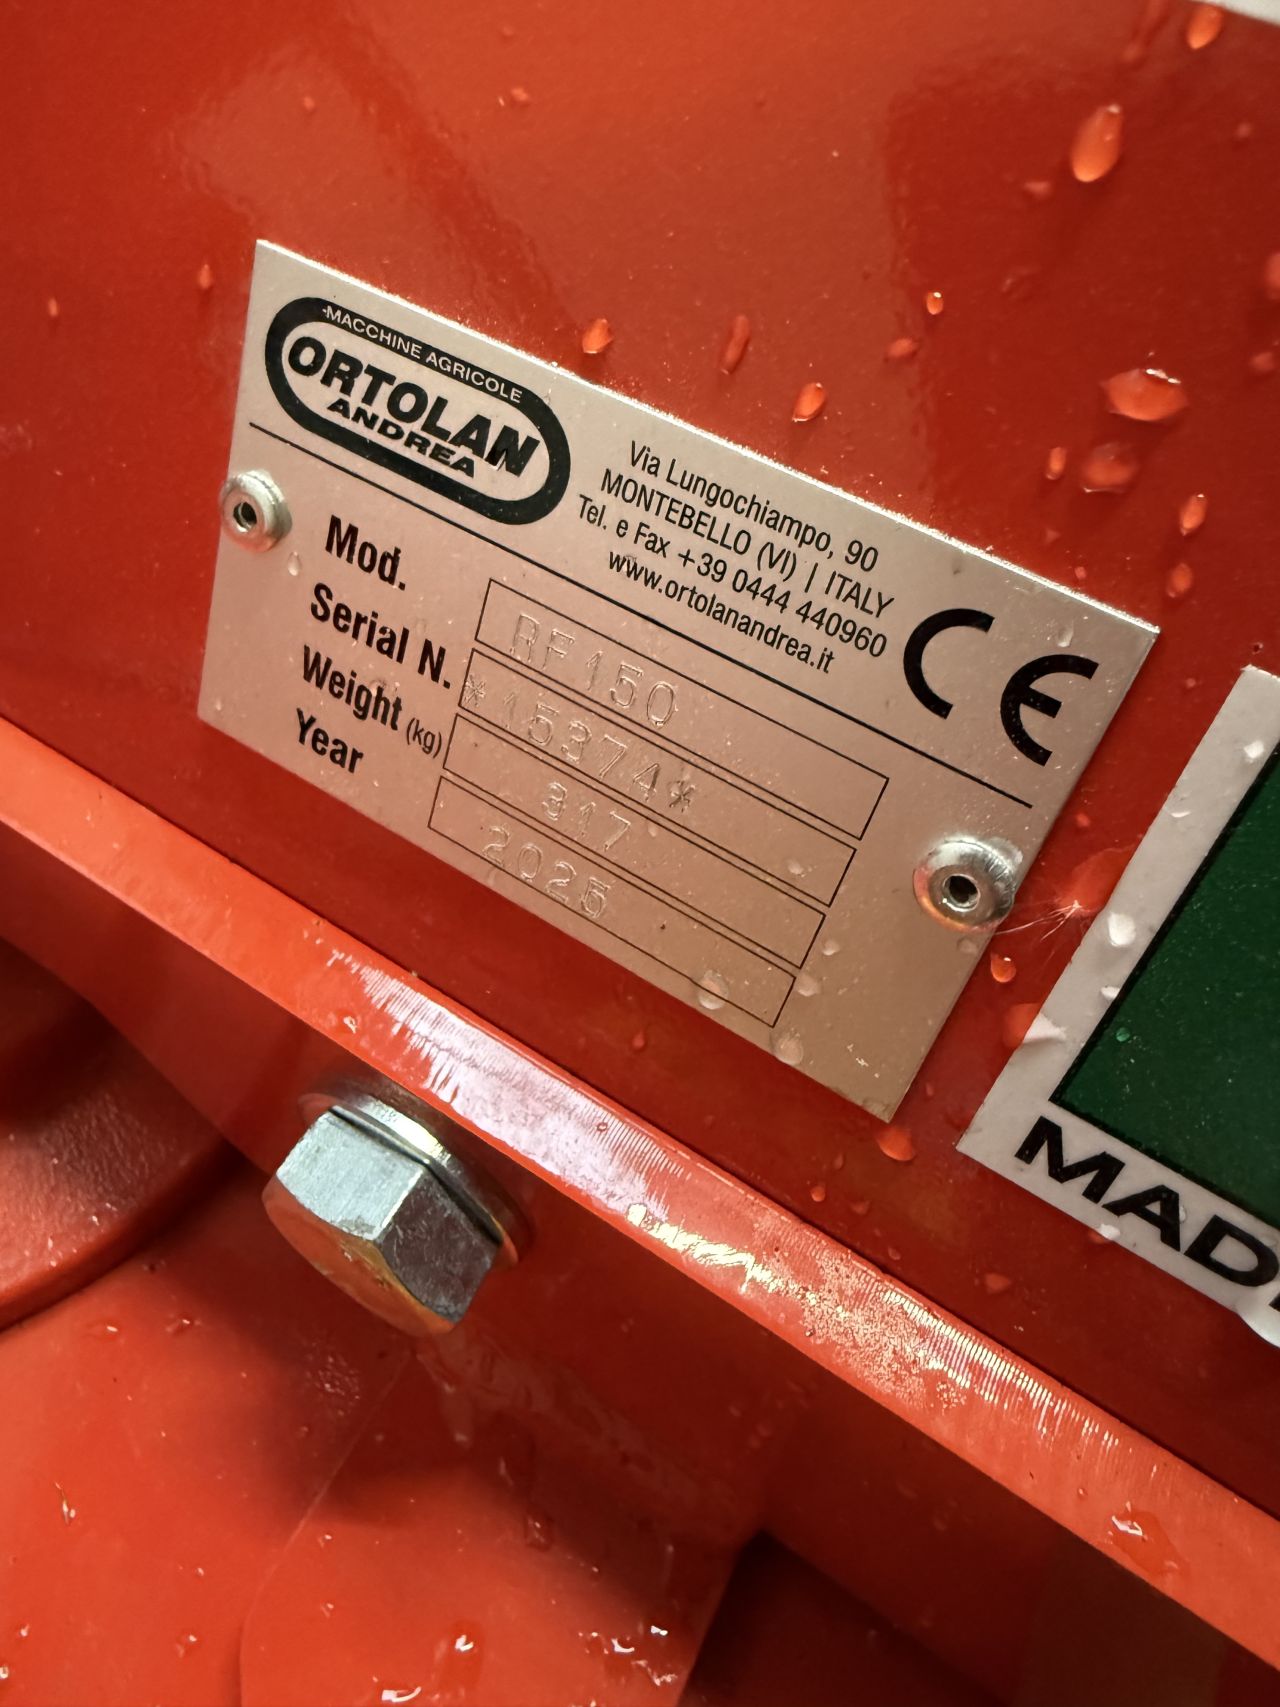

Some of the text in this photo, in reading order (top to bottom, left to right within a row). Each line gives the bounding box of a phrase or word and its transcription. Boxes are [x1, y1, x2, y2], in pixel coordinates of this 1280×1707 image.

[288, 336, 540, 477] ORTOLAN
[425, 352, 523, 403] AGRICOLE
[326, 398, 476, 478] ANDREA
[326, 514, 406, 591] Mod.
[600, 468, 752, 554] MONTEBELLO
[757, 542, 797, 582] (VI)
[824, 571, 895, 618] ITALY
[630, 440, 878, 572] Via Lungochiampo, 90
[577, 494, 887, 658] Tel. e Fax +39 0444 440960
[608, 552, 834, 673] www.ortolanandrea.it
[311, 582, 451, 689] Serial N.
[510, 613, 679, 728] RF150
[903, 608, 1099, 766] CE
[296, 707, 364, 773] Year
[303, 644, 442, 759] Weight (kg)
[483, 824, 611, 918] 2025
[542, 781, 631, 852] 317
[1014, 1115, 1280, 1313] MAD
